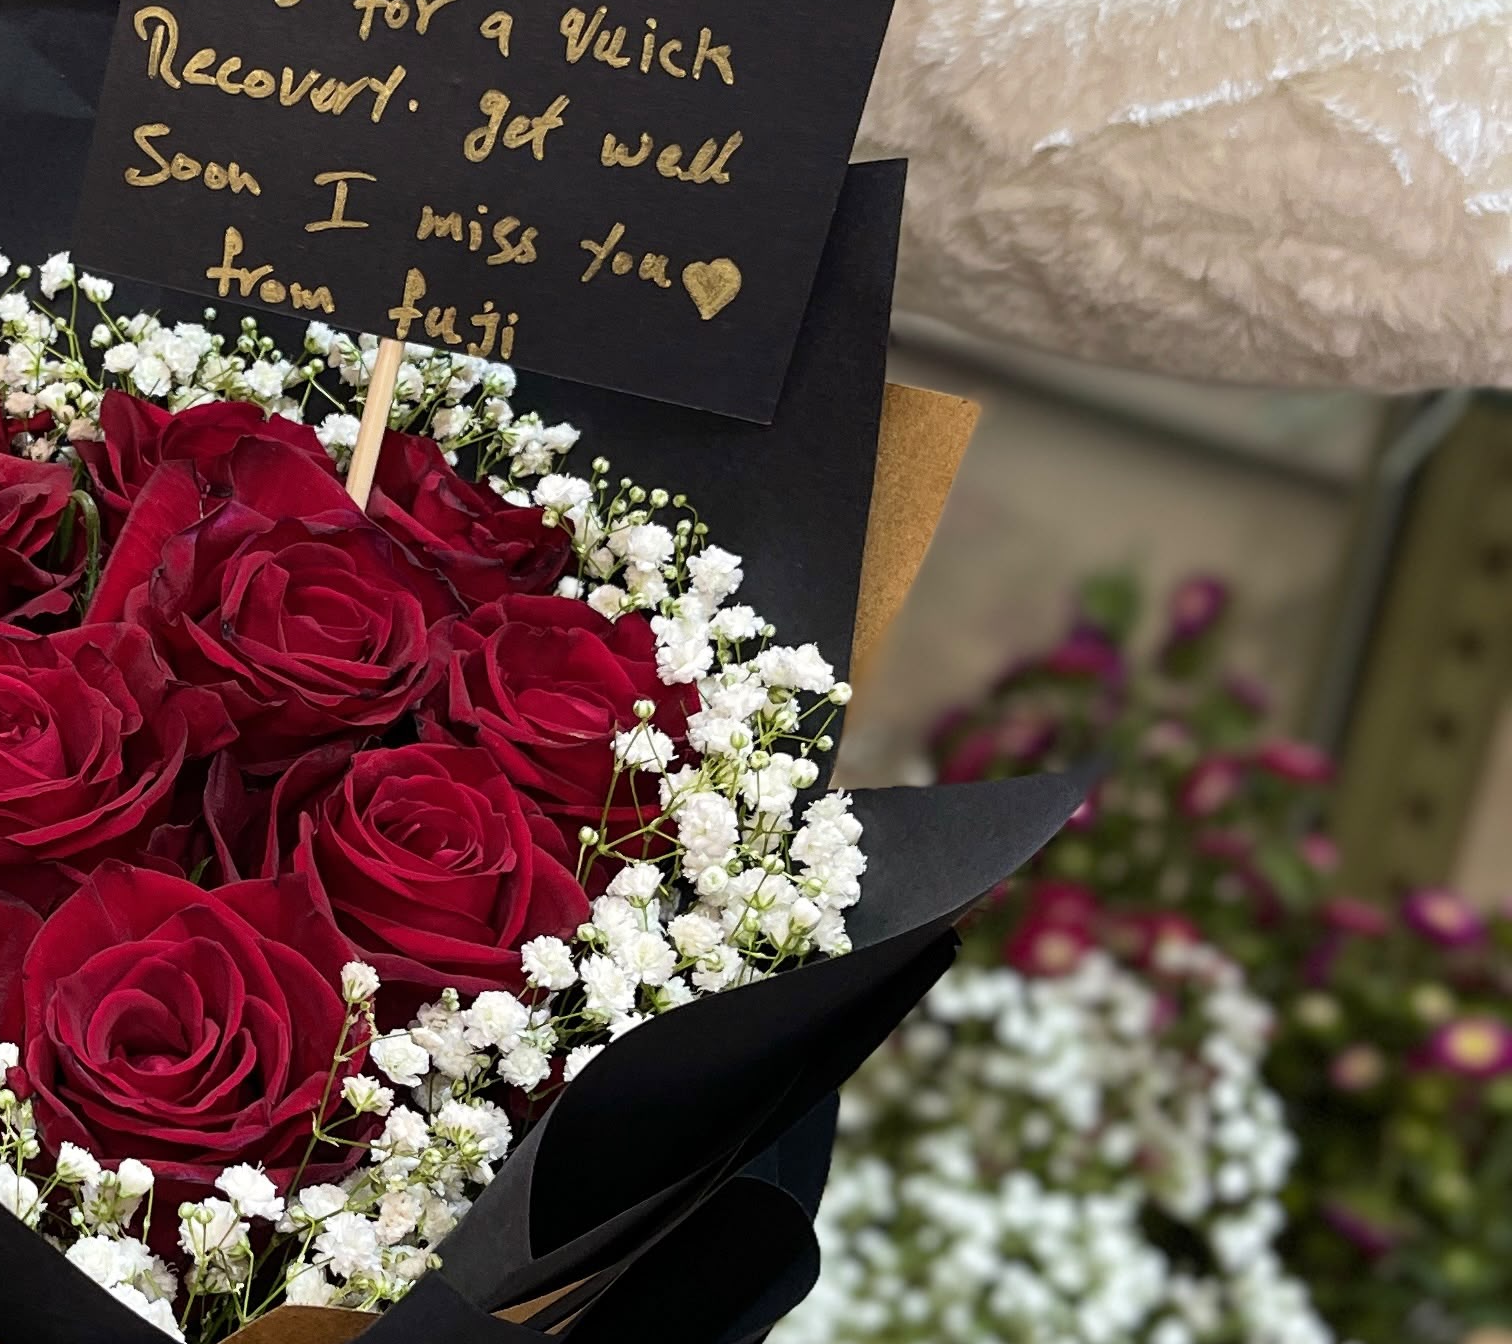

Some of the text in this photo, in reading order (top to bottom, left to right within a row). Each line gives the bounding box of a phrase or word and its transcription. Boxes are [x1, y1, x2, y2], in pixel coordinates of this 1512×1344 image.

[480, 11, 513, 55] a
[464, 90, 568, 162] get
[601, 132, 742, 184] well
[306, 172, 376, 232] I
[417, 205, 537, 265] miss
[206, 224, 338, 311] from
